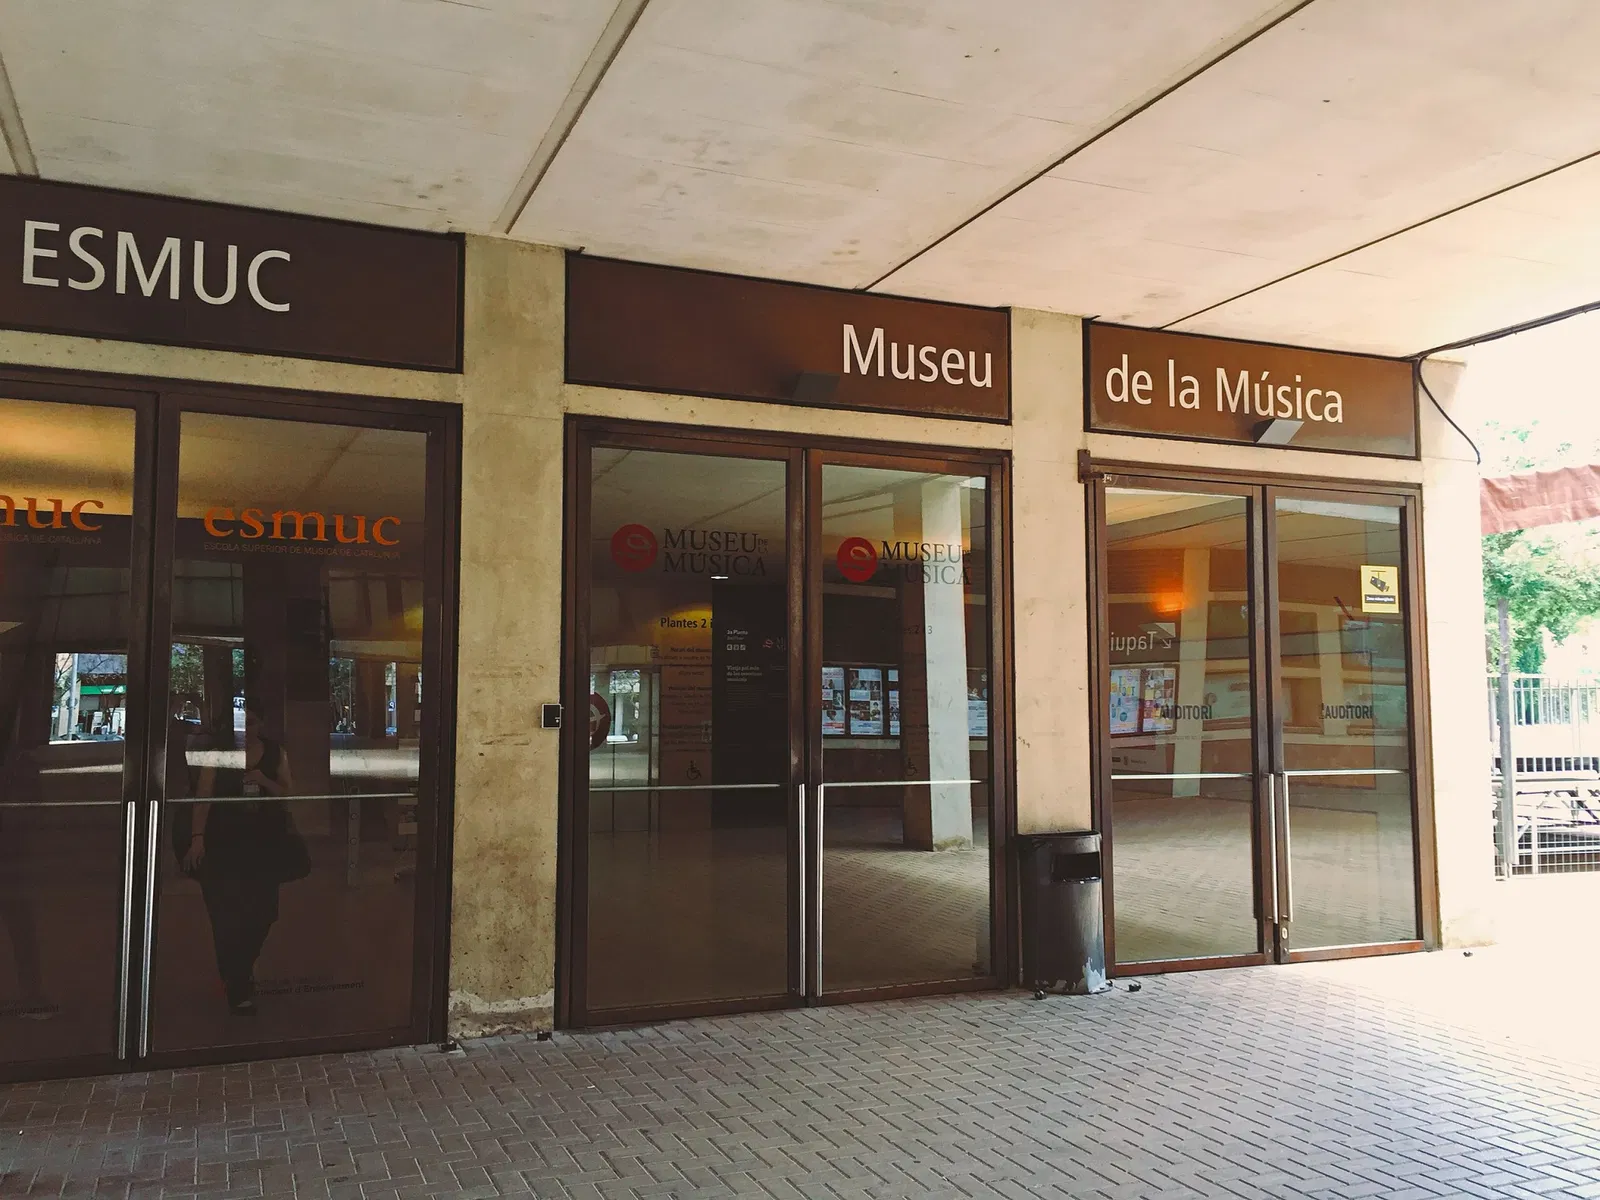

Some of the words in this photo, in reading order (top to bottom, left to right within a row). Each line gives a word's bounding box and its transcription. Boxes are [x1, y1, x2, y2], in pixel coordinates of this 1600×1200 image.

[22, 219, 292, 312] ESMUC
[841, 323, 993, 389] Museu
[1105, 354, 1153, 405] de
[1168, 359, 1200, 410] la
[1216, 368, 1344, 424] Música
[203, 506, 401, 546] esmuc
[203, 542, 240, 553] ESCOLA
[241, 543, 288, 554] SUPERIOR
[289, 545, 302, 555] DE
[663, 527, 759, 553] MUSEU
[881, 540, 963, 564] MUSEU
[663, 551, 767, 577] MÚSICA
[660, 616, 698, 628] Plantes
[701, 618, 707, 629] 2
